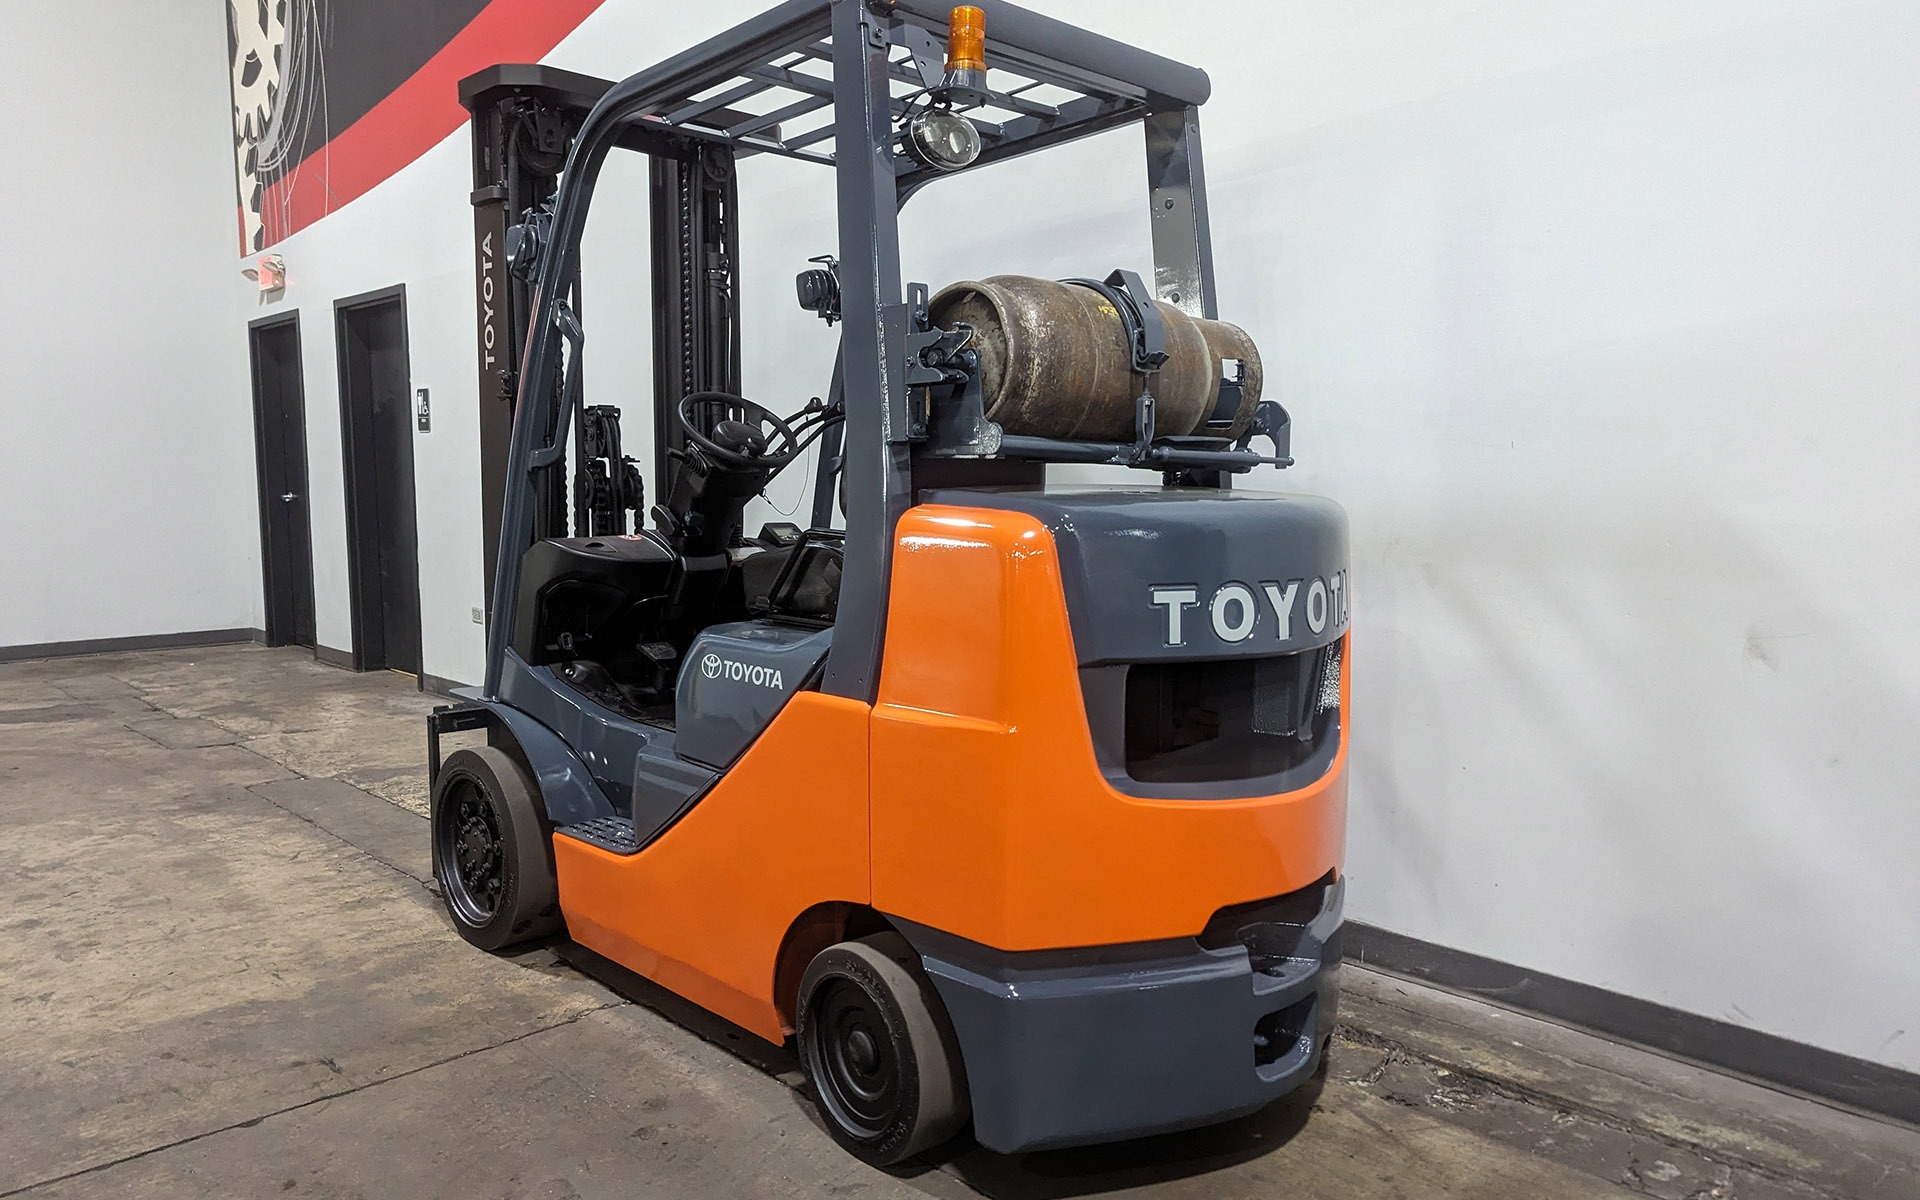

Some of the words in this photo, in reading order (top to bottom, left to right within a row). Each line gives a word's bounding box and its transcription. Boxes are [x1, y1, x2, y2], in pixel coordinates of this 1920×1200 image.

[482, 231, 495, 371] TOYOTA
[1151, 571, 1348, 645] TOYOTA
[723, 660, 784, 690] TOYOTA
